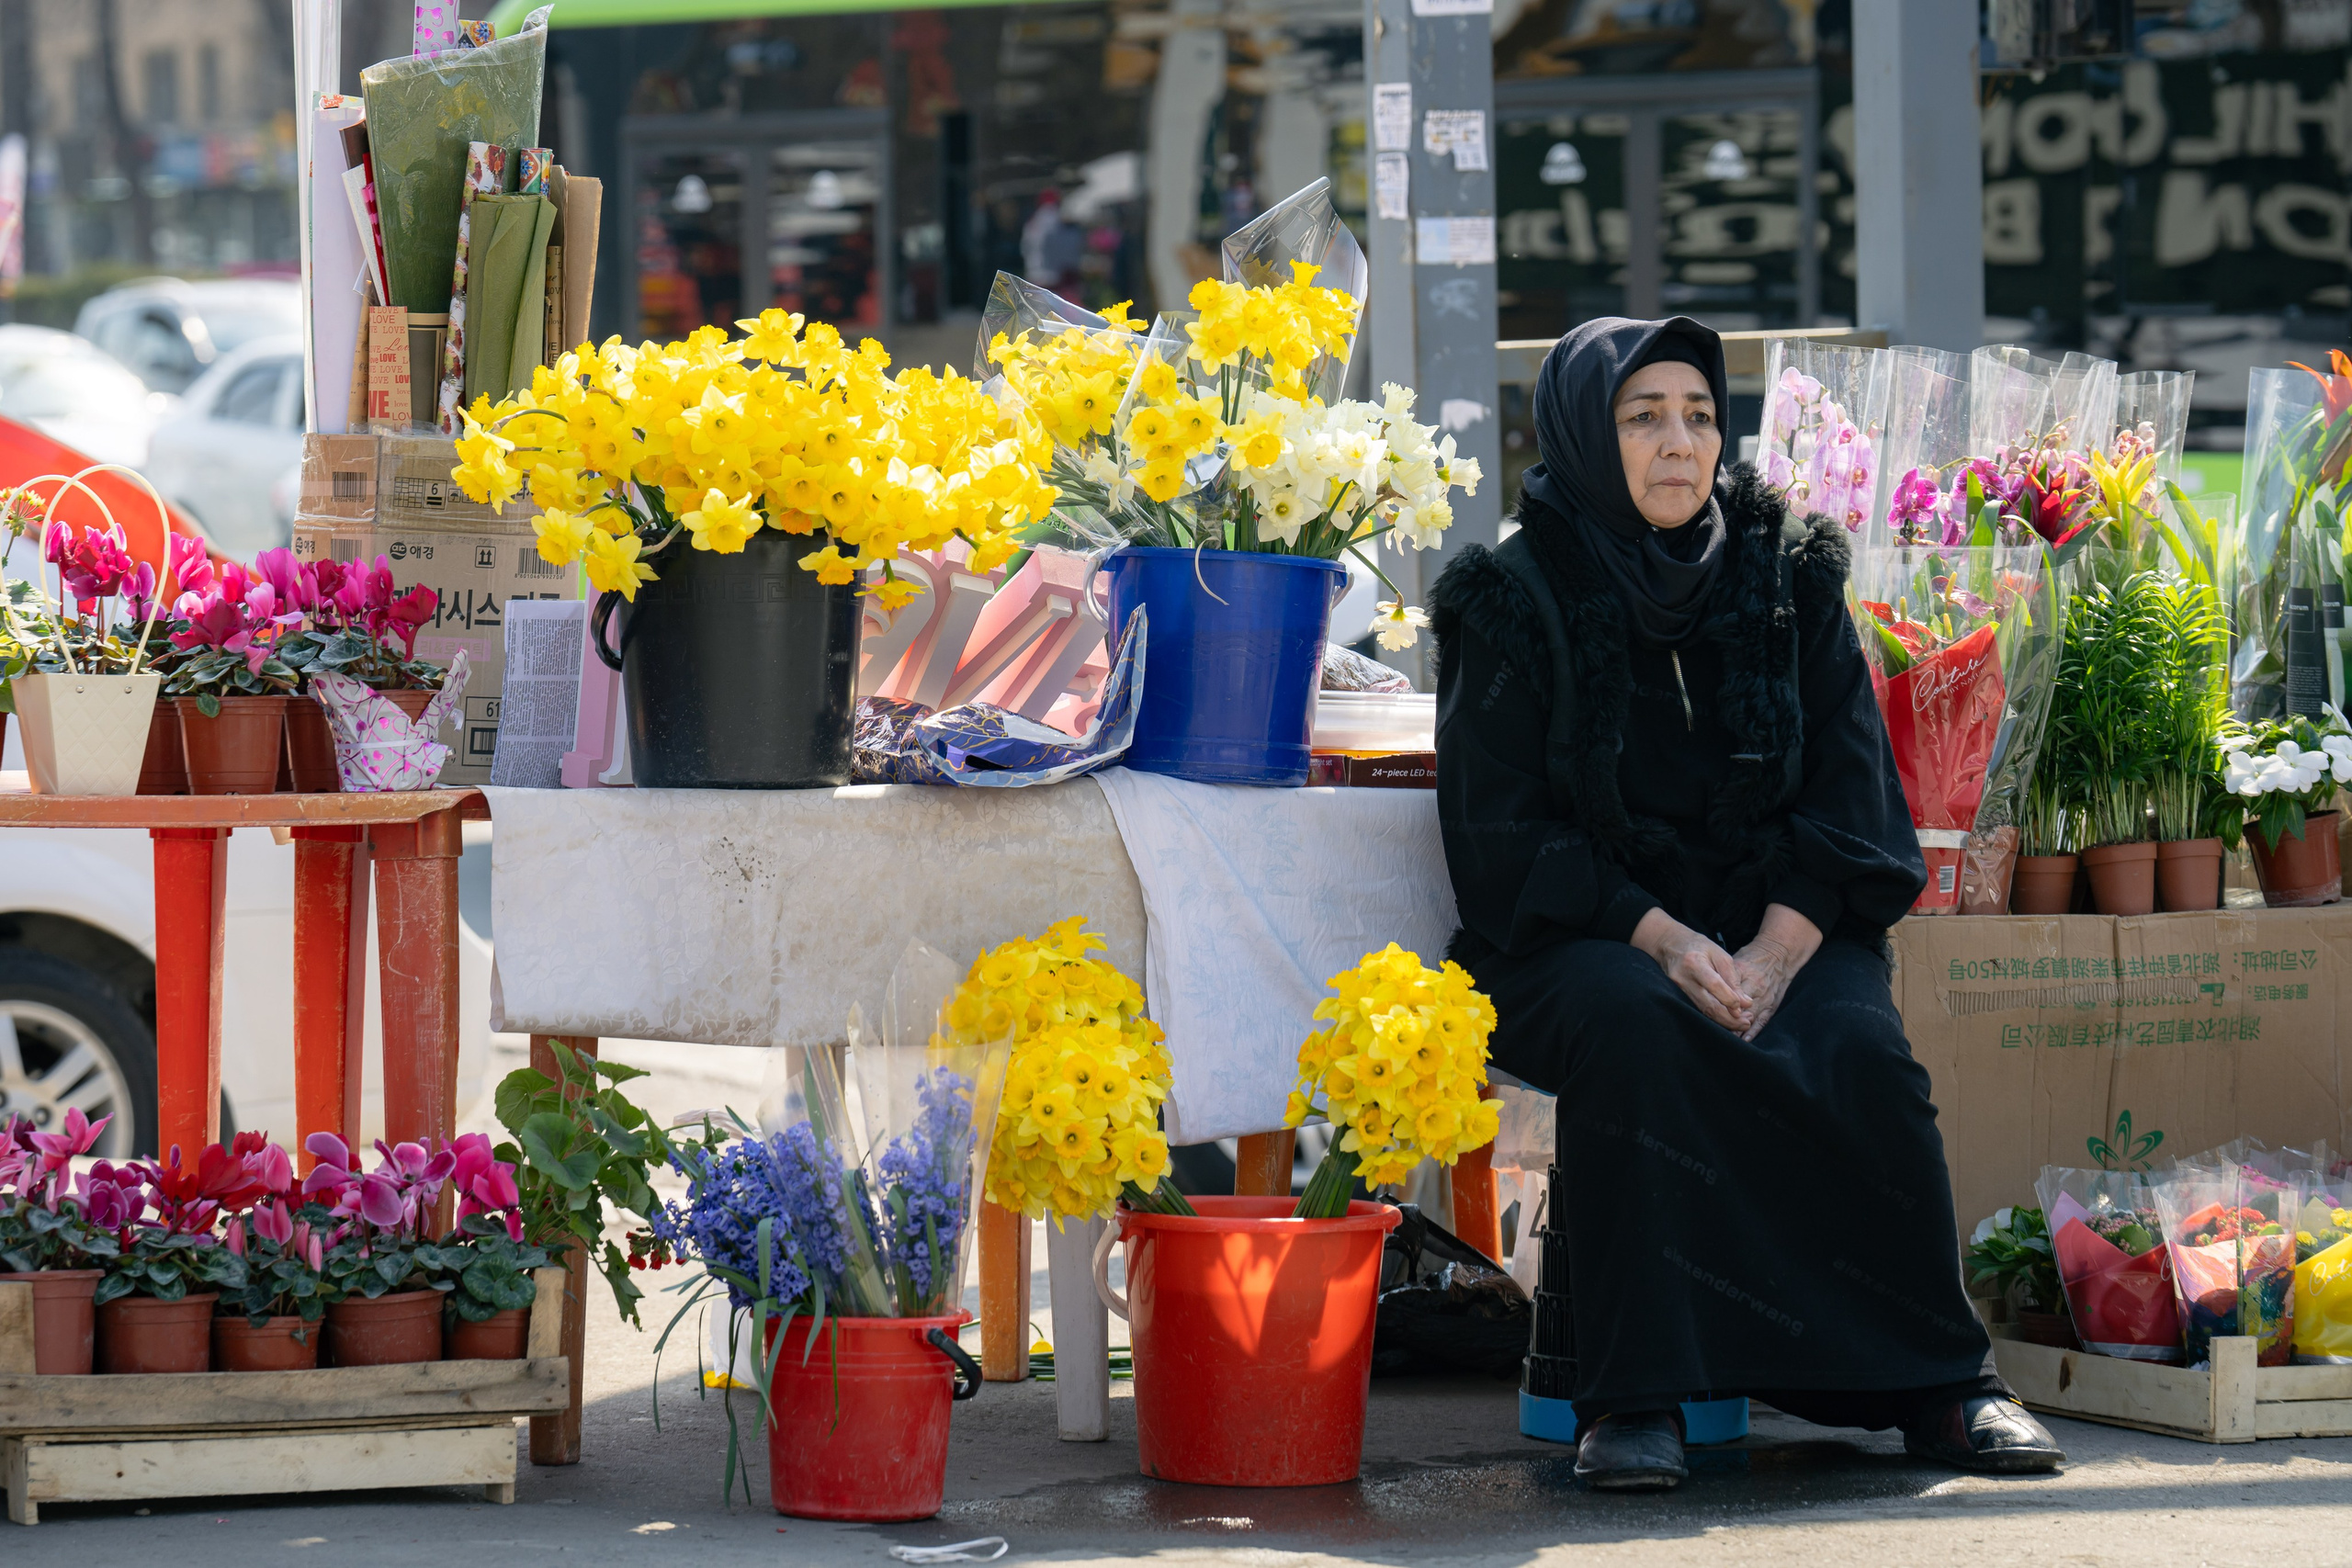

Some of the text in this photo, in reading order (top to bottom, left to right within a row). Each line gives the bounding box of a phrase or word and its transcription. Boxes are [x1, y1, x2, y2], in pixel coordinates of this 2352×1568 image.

[372, 314, 395, 323] LOVE
[382, 325, 405, 334] LOVE
[379, 353, 397, 363] LOVE
[379, 365, 403, 374] LOVE
[393, 400, 409, 408] love
[431, 482, 438, 496] 6
[409, 545, 435, 560] 애경
[1912, 653, 1988, 713] Couture
[1372, 768, 1408, 779] 24-piece
[1409, 768, 1425, 777] LED
[2233, 949, 2318, 974] 公司地址：
[2247, 983, 2310, 1002] 服务电话：
[1662, 1245, 1805, 1338] alexanderwang
